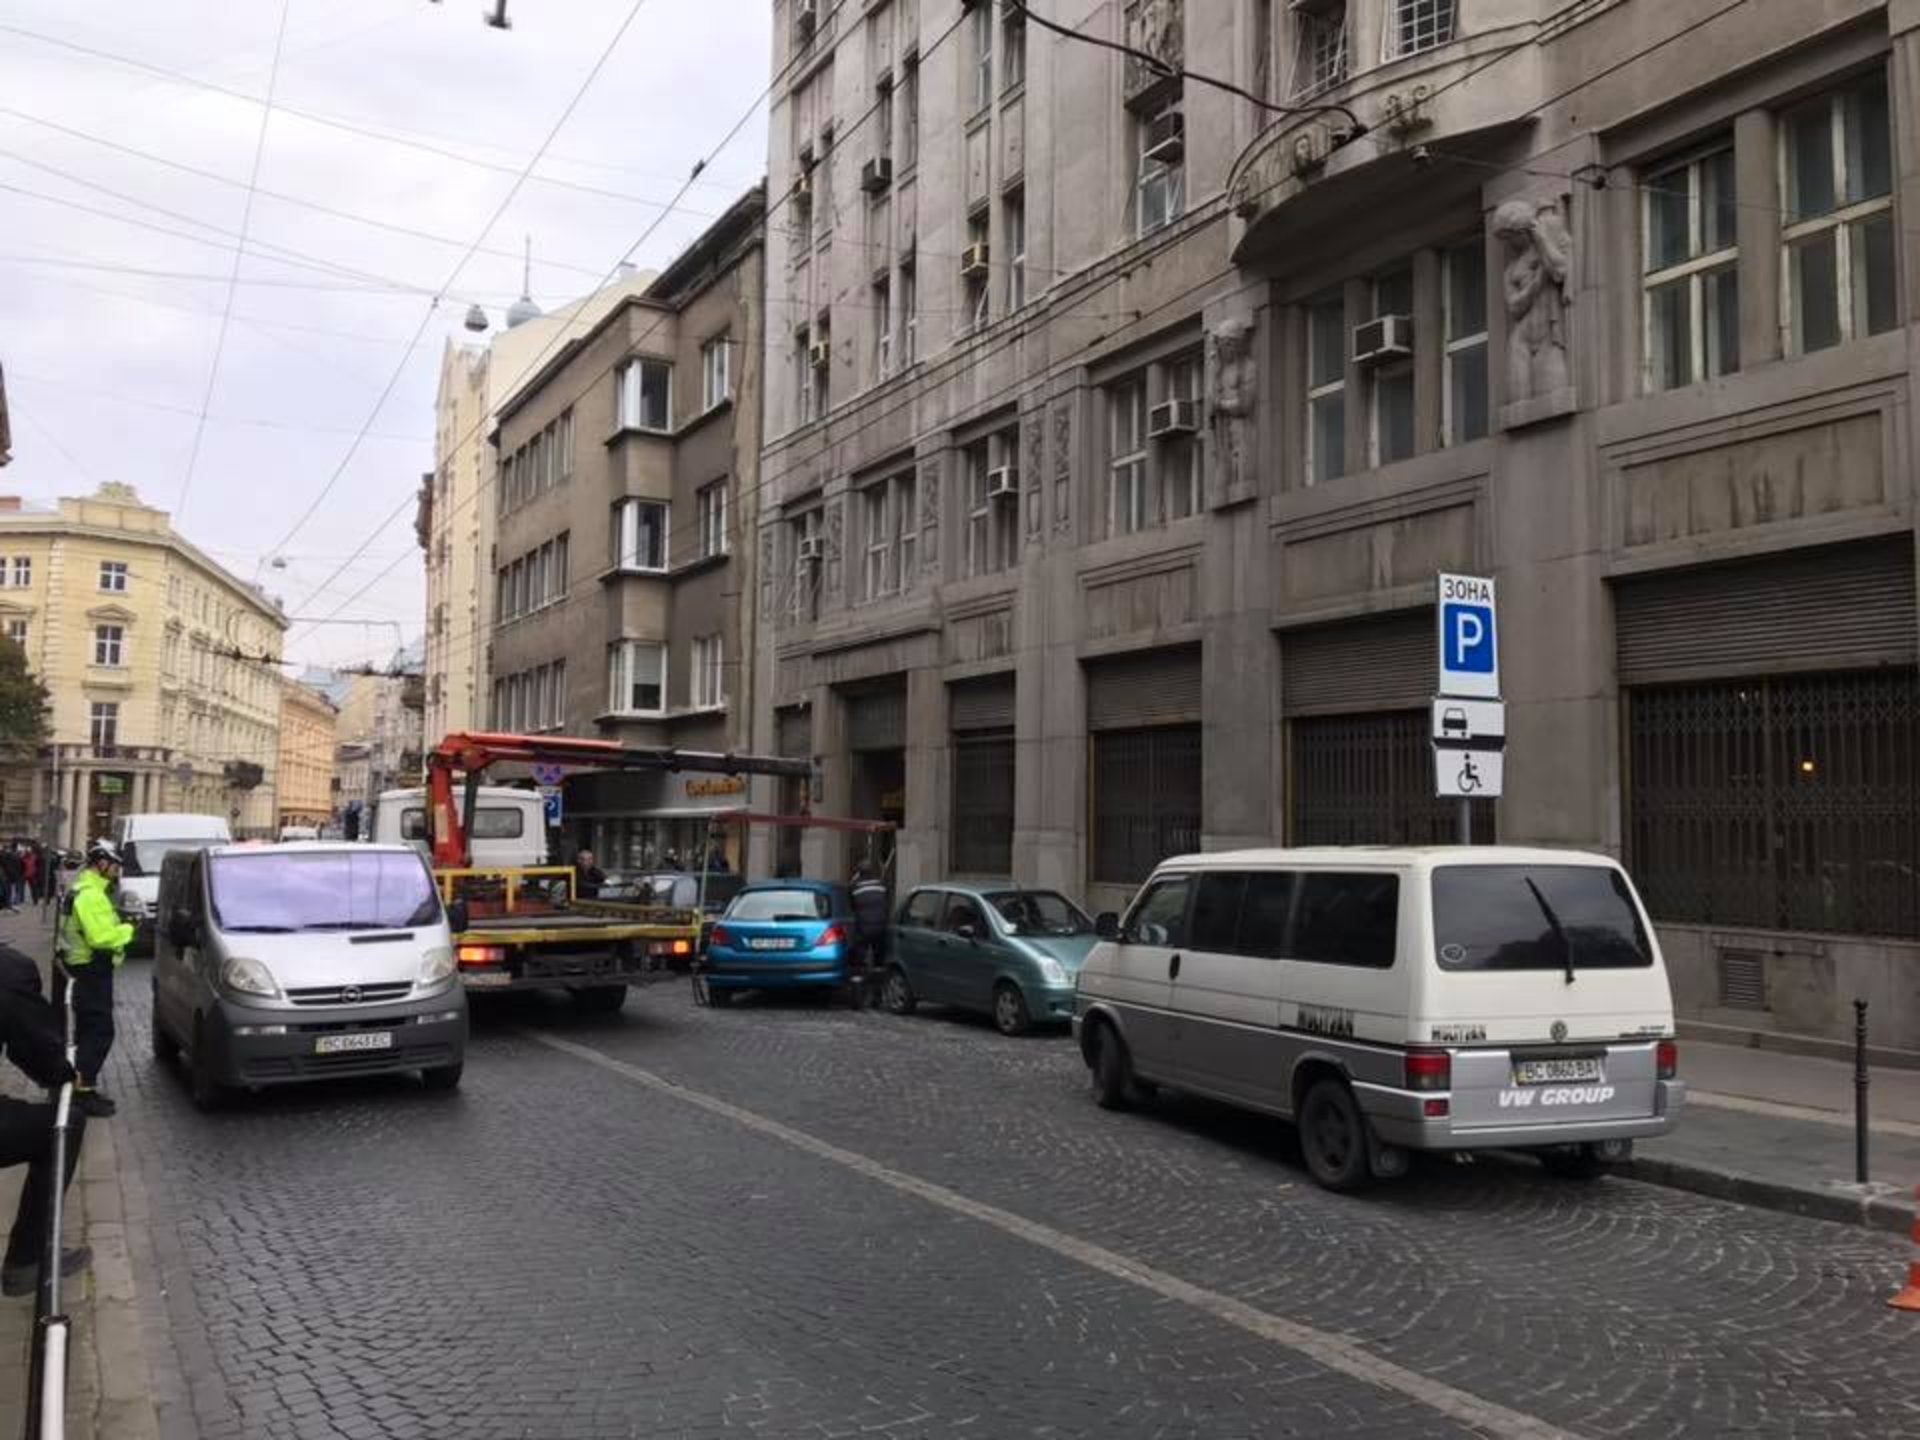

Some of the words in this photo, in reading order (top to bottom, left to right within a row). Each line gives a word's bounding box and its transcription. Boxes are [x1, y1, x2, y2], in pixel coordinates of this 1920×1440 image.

[1445, 579, 1491, 602] ЗОНА
[1457, 612, 1483, 663] P
[1499, 1089, 1536, 1107] VW
[1540, 1087, 1615, 1105] GROUP
